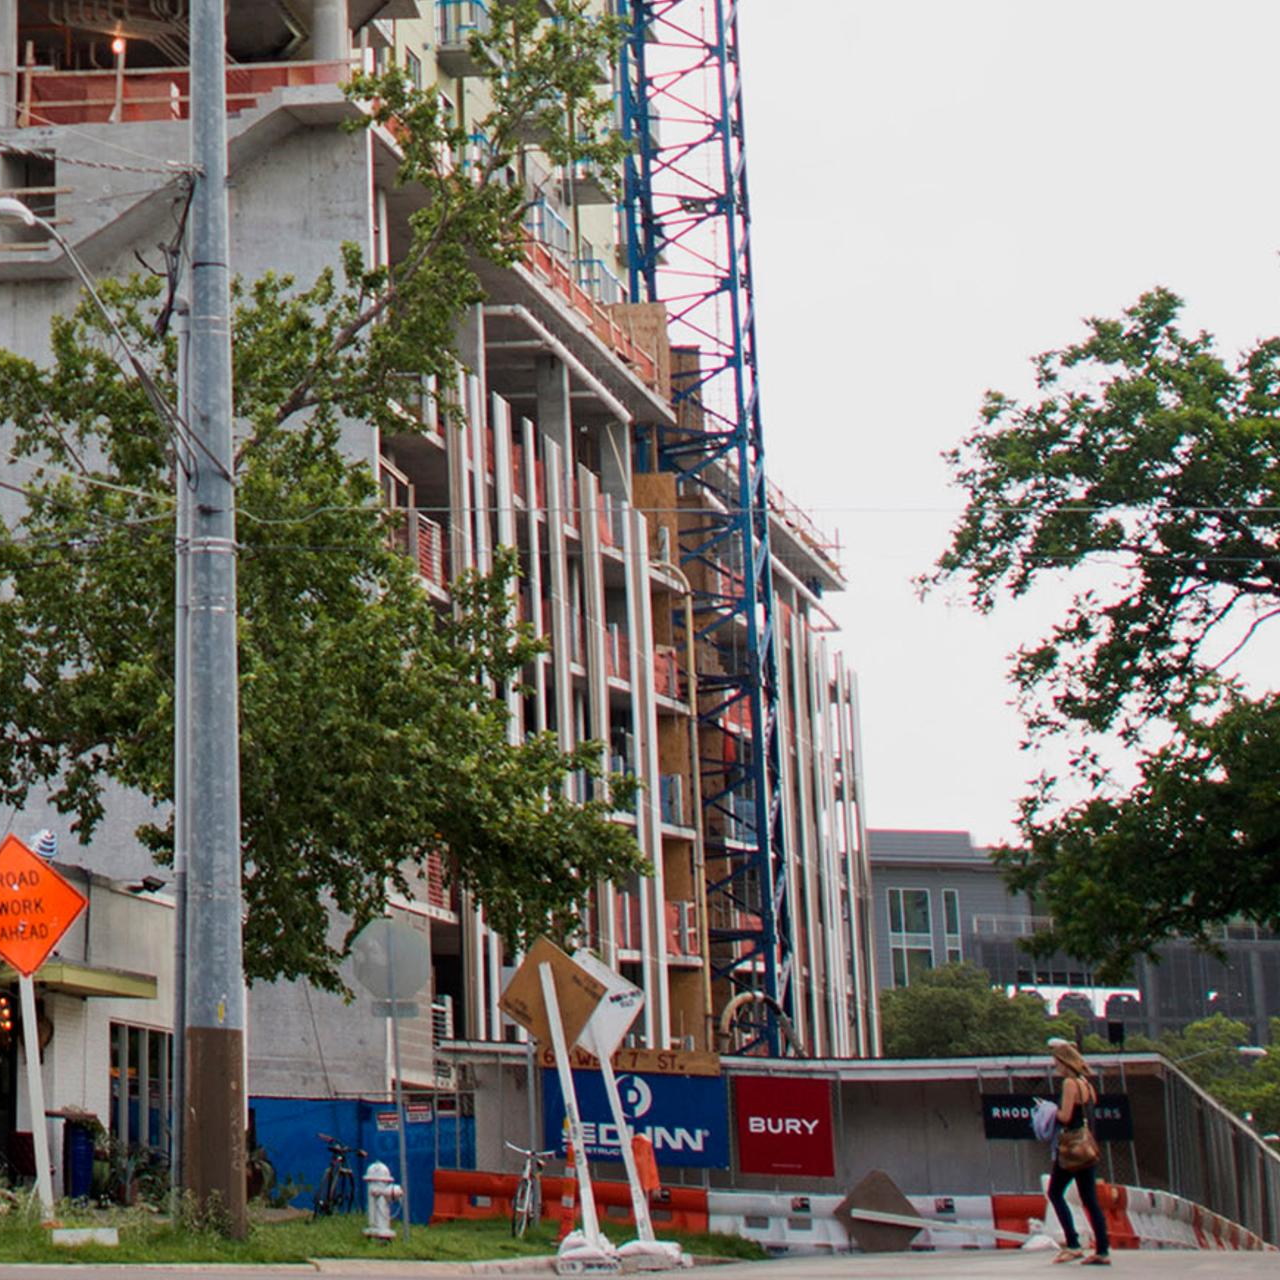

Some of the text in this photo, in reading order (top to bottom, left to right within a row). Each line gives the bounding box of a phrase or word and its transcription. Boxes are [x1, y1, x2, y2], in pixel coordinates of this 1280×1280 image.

[0, 922, 49, 942] AHEAD
[575, 1049, 622, 1069] WET
[749, 1117, 819, 1135] BURY
